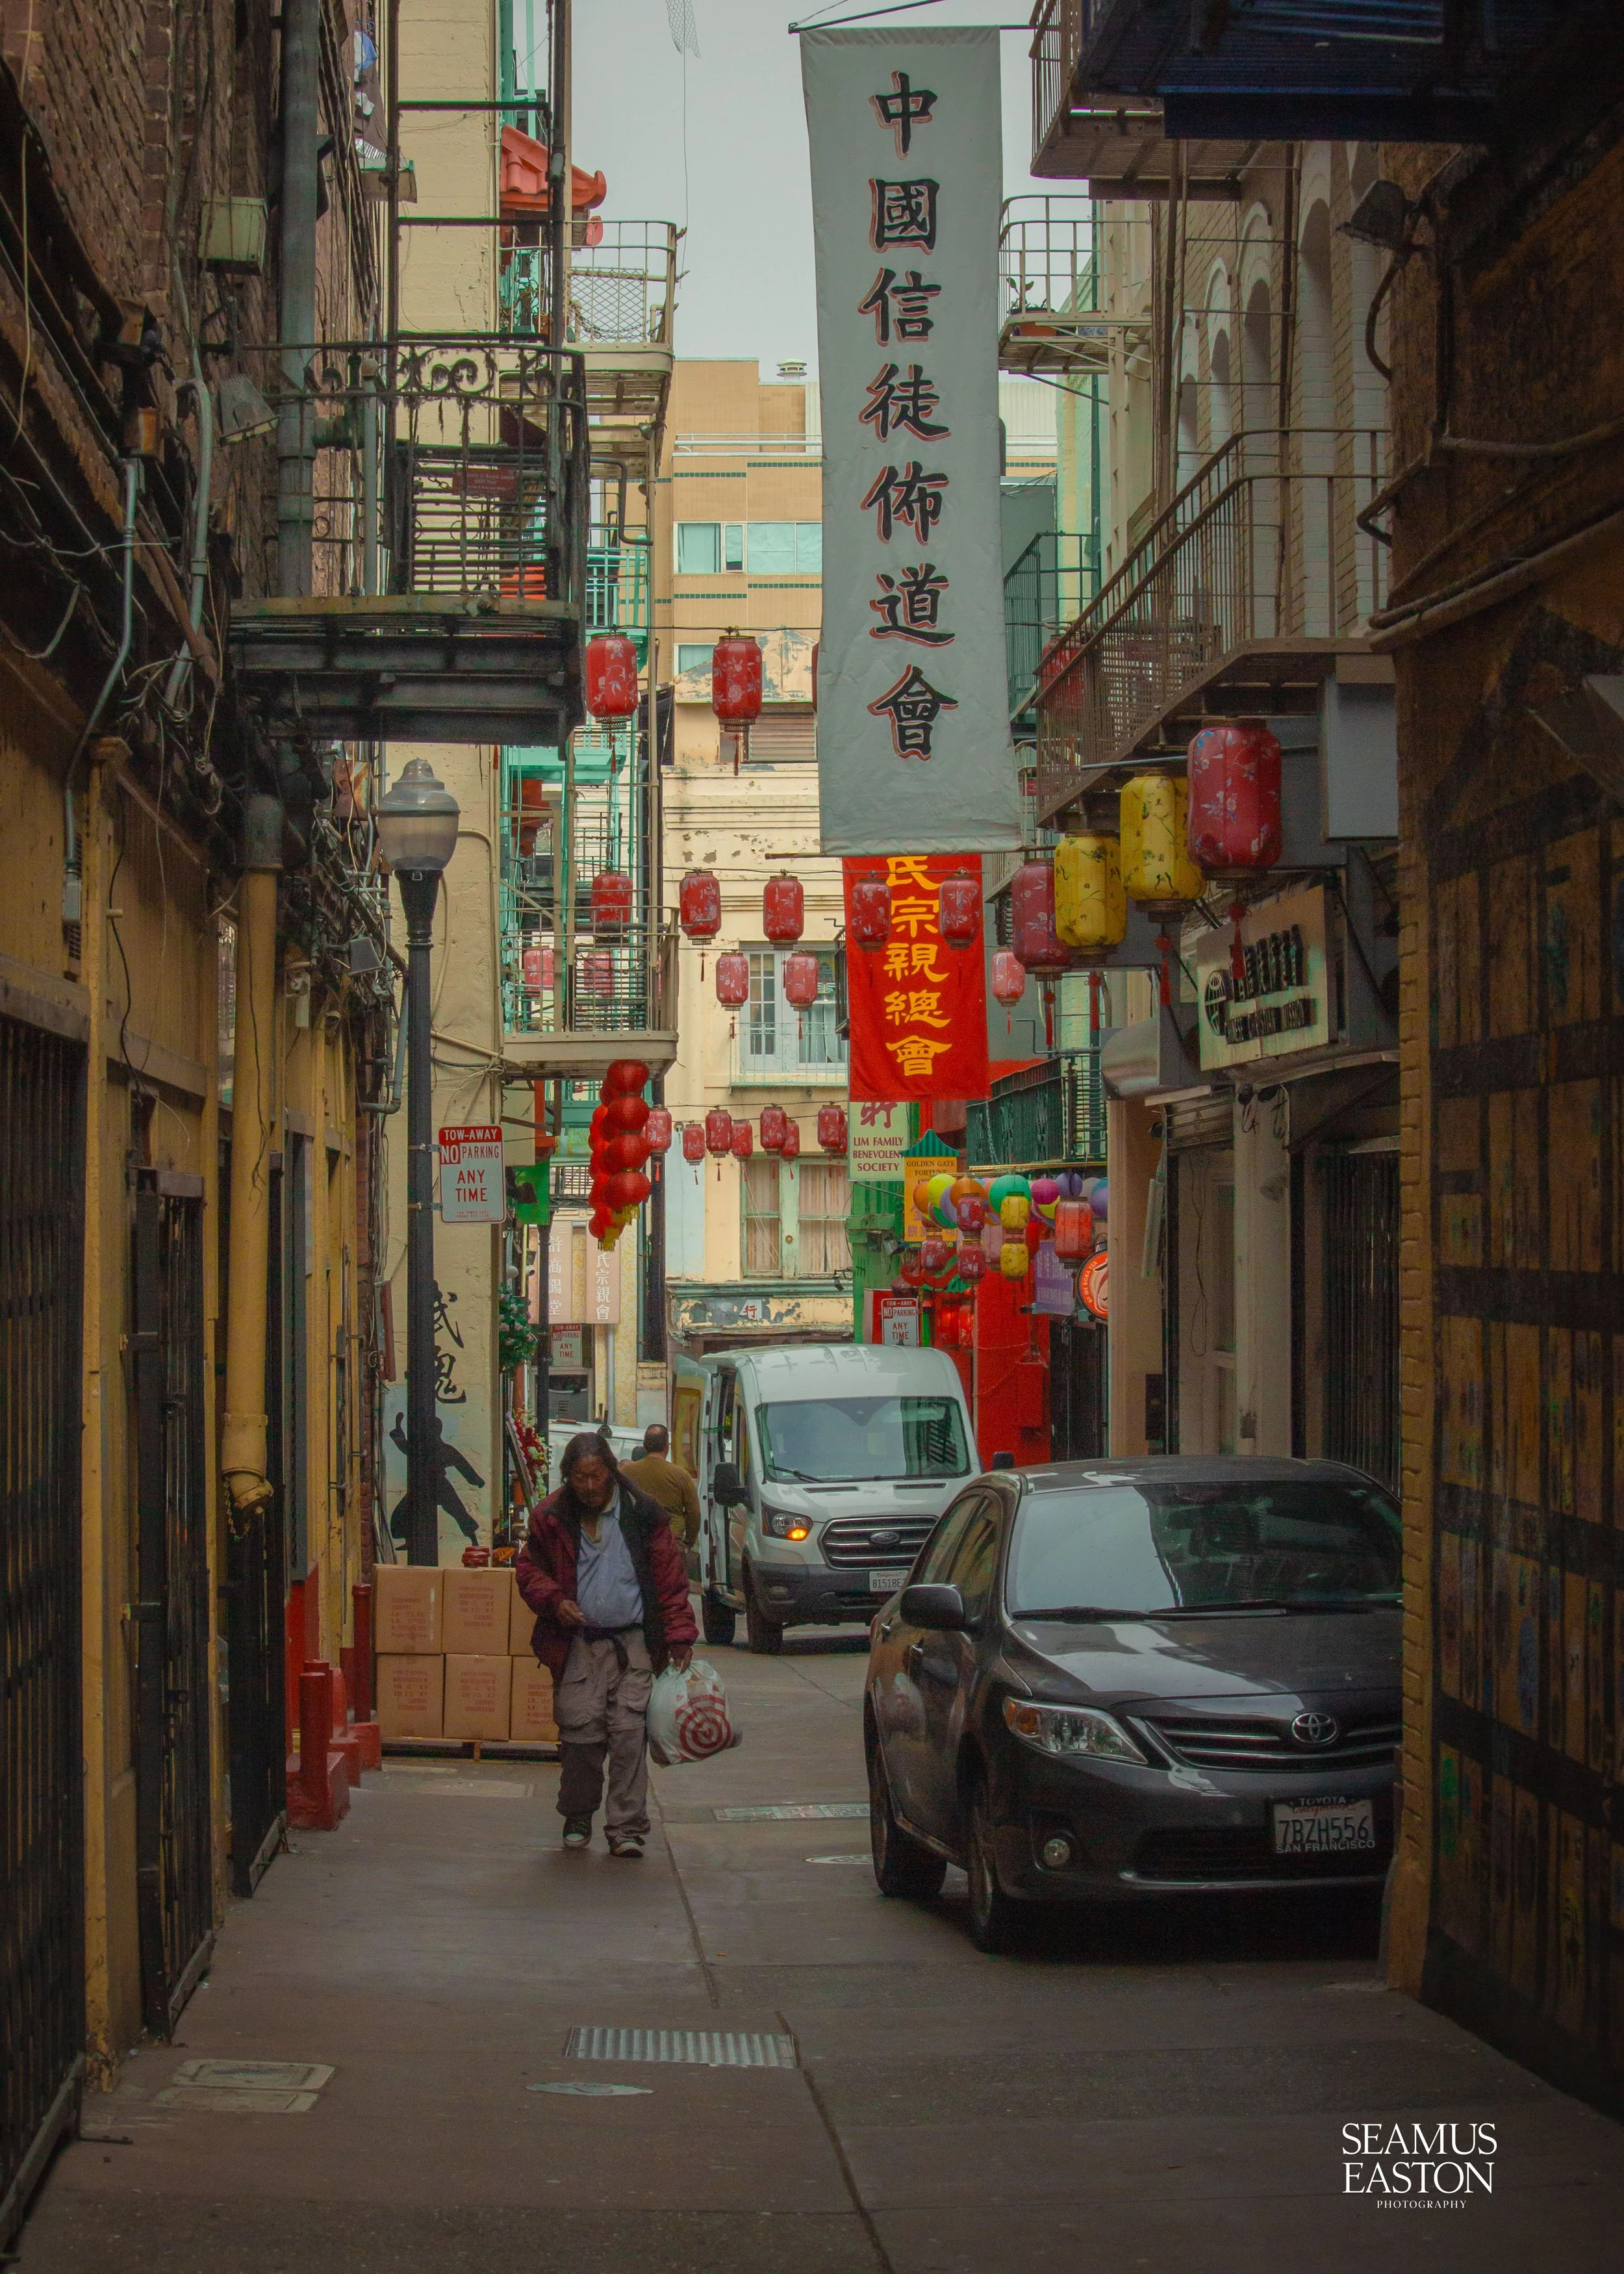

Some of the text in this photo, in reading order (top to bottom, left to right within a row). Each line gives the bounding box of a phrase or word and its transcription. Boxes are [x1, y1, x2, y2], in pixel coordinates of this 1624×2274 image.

[857, 70, 959, 761] 中國信徒佈道會
[444, 1129, 498, 1141] TOW-AWAY
[854, 1137, 904, 1146] LIM FAMILY
[440, 1144, 500, 1164] NO PARKING
[857, 1162, 900, 1171] SOCIETY
[457, 1169, 485, 1184] ANY
[455, 1188, 488, 1202] TIME
[1089, 1261, 1098, 1270] TEA
[883, 1307, 893, 1317] NO
[893, 1322, 908, 1330] ANY
[553, 1332, 561, 1340] NO
[892, 1331, 909, 1340] TIME
[1299, 1796, 1347, 1806] TOYOTA
[1278, 1815, 1369, 1845] 7BZH556
[1276, 1839, 1375, 1854] SAN FRANCISCO
